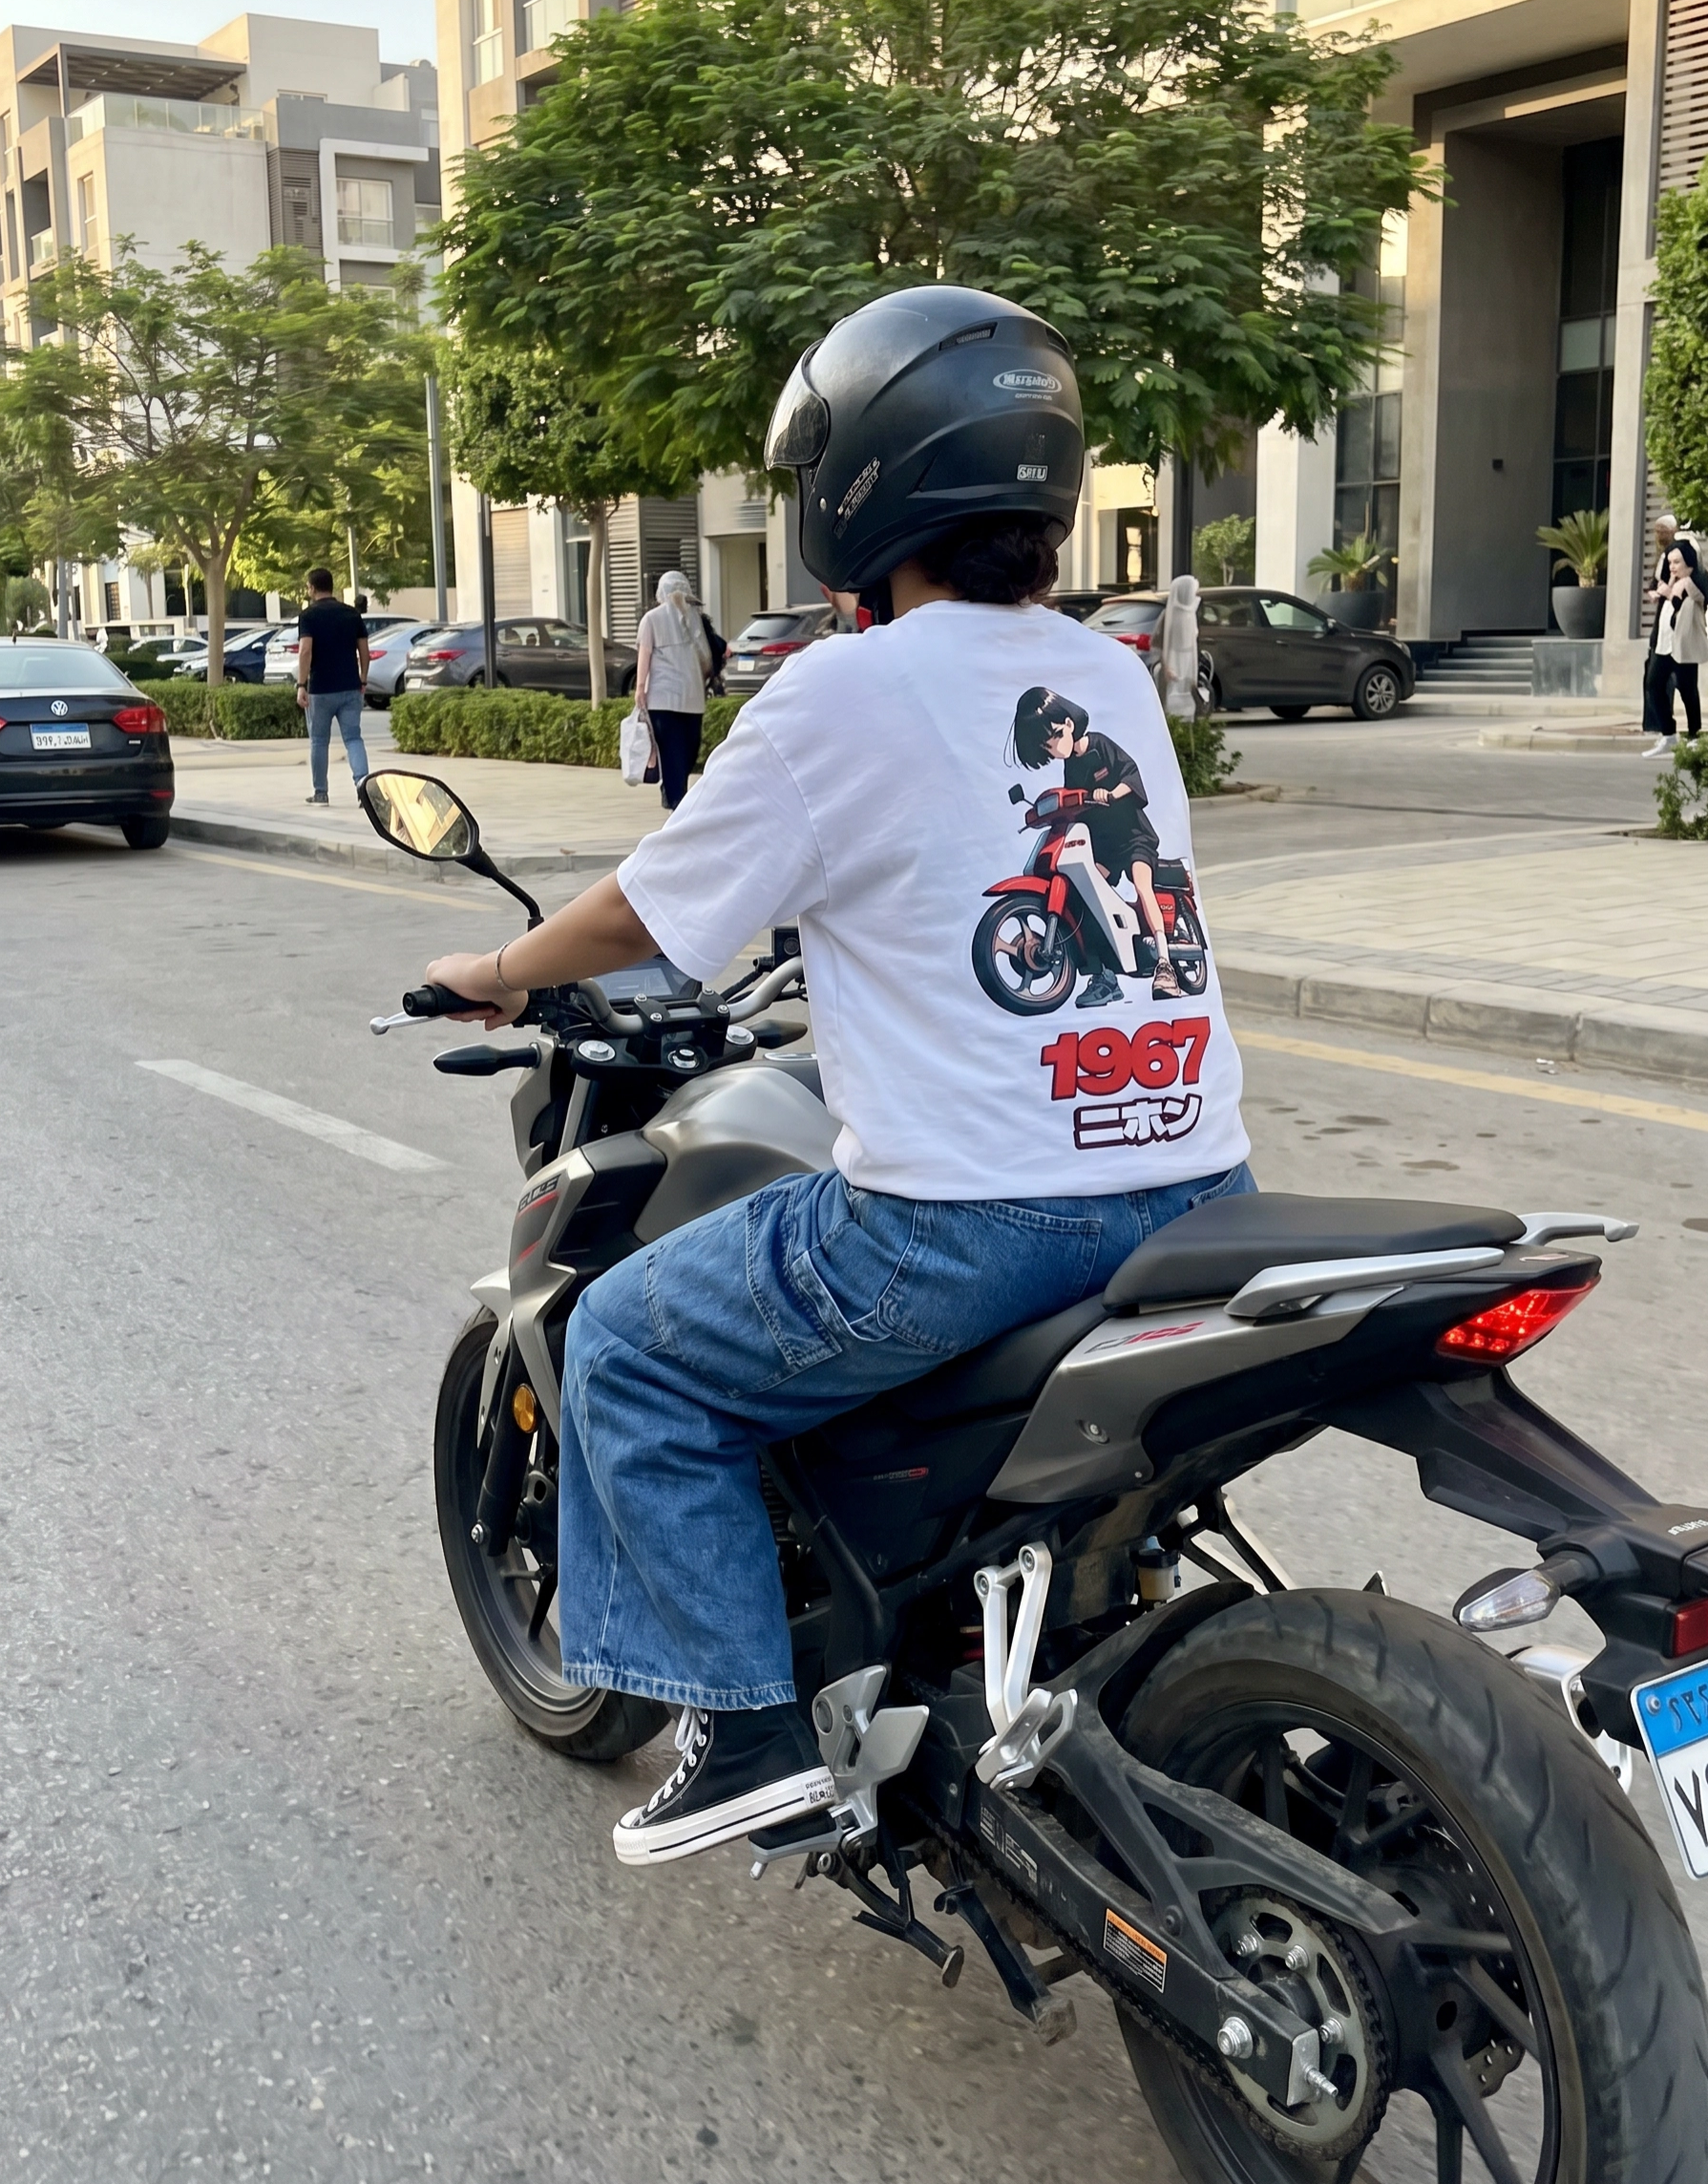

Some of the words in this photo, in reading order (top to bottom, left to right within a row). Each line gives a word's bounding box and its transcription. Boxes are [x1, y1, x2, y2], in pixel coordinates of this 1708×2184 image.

[1041, 1016, 1211, 1101] 1967
[1073, 1092, 1202, 1151] ニホン
